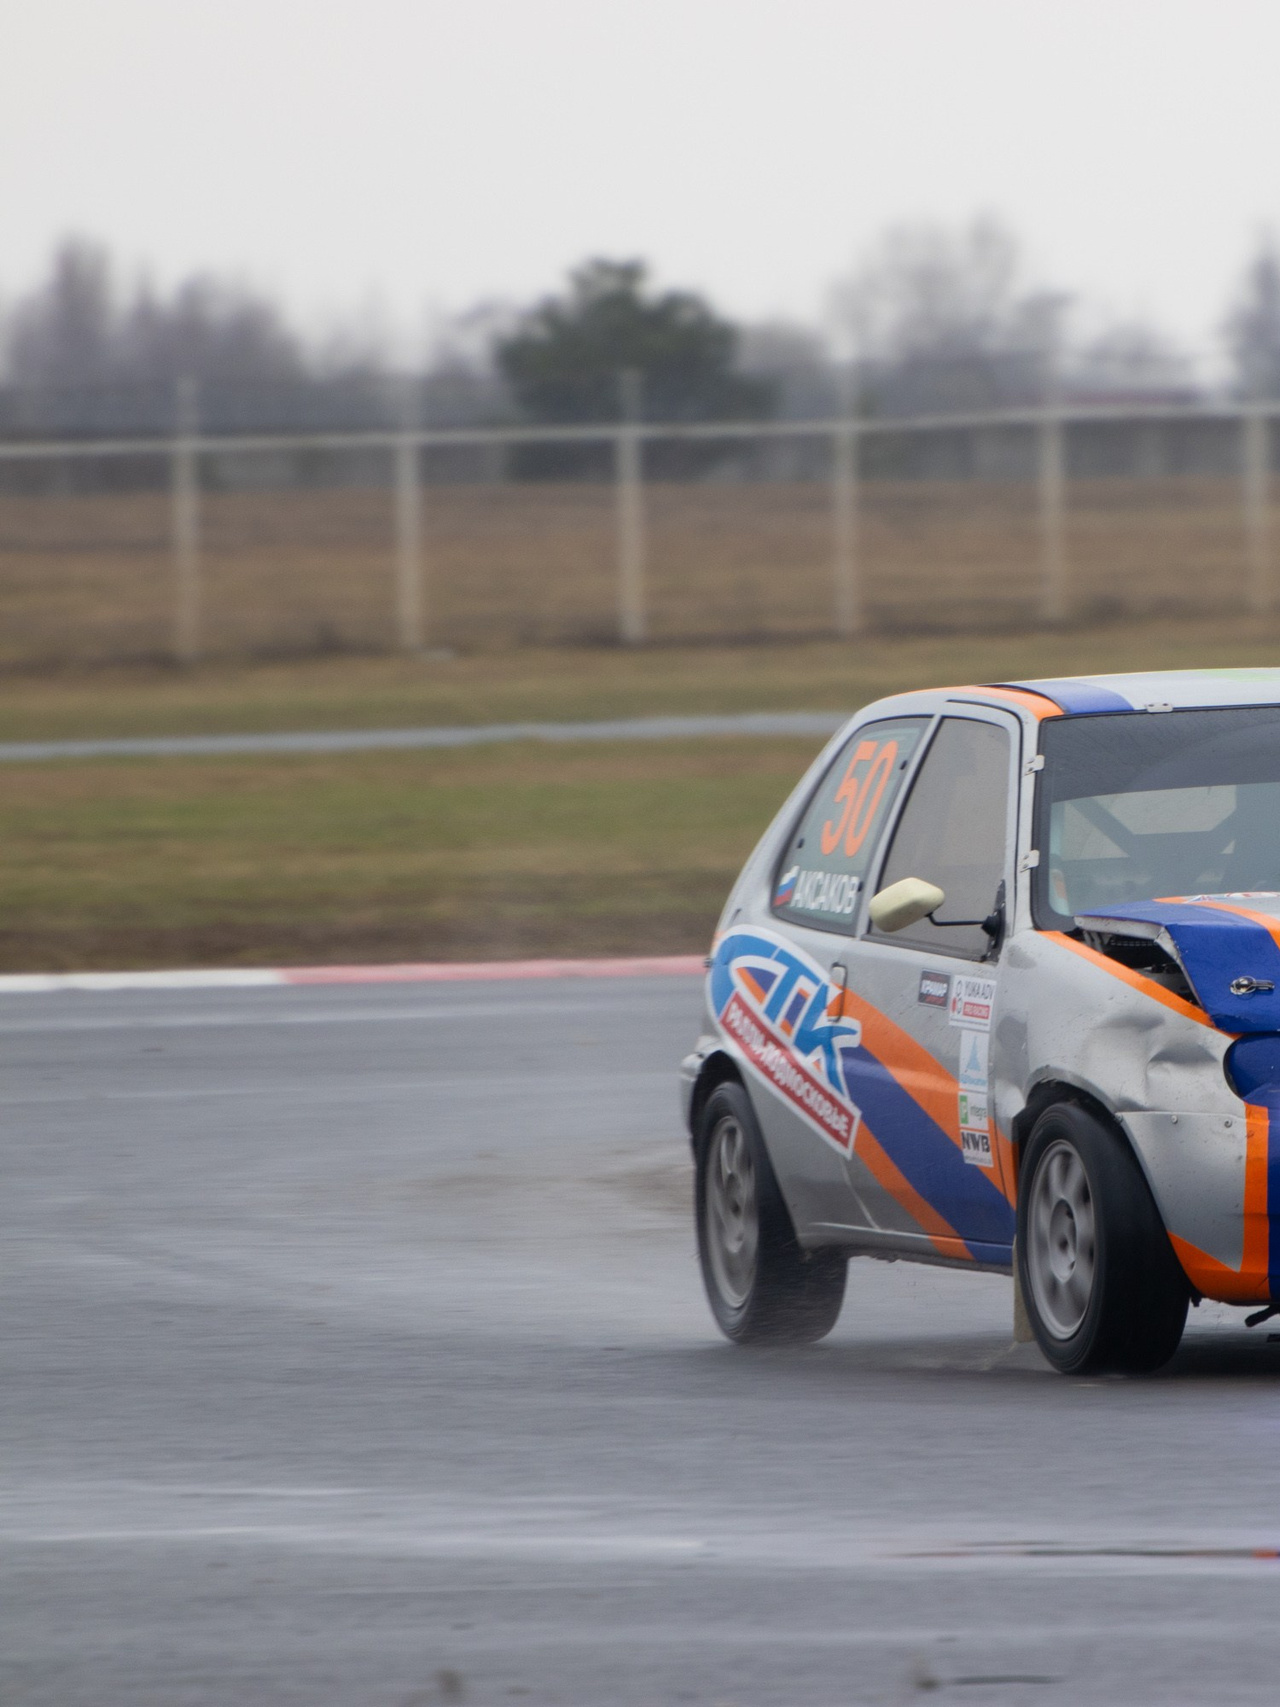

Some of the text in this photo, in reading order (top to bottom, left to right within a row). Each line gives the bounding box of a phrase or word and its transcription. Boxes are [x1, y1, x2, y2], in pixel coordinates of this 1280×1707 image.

[821, 740, 898, 857] 50
[791, 870, 860, 914] АКСАКОВ
[711, 934, 858, 1097] СТК
[726, 1002, 849, 1138] РАЛЛИ-ПОДМОСКОВЬЕ
[961, 1131, 990, 1153] NWB
